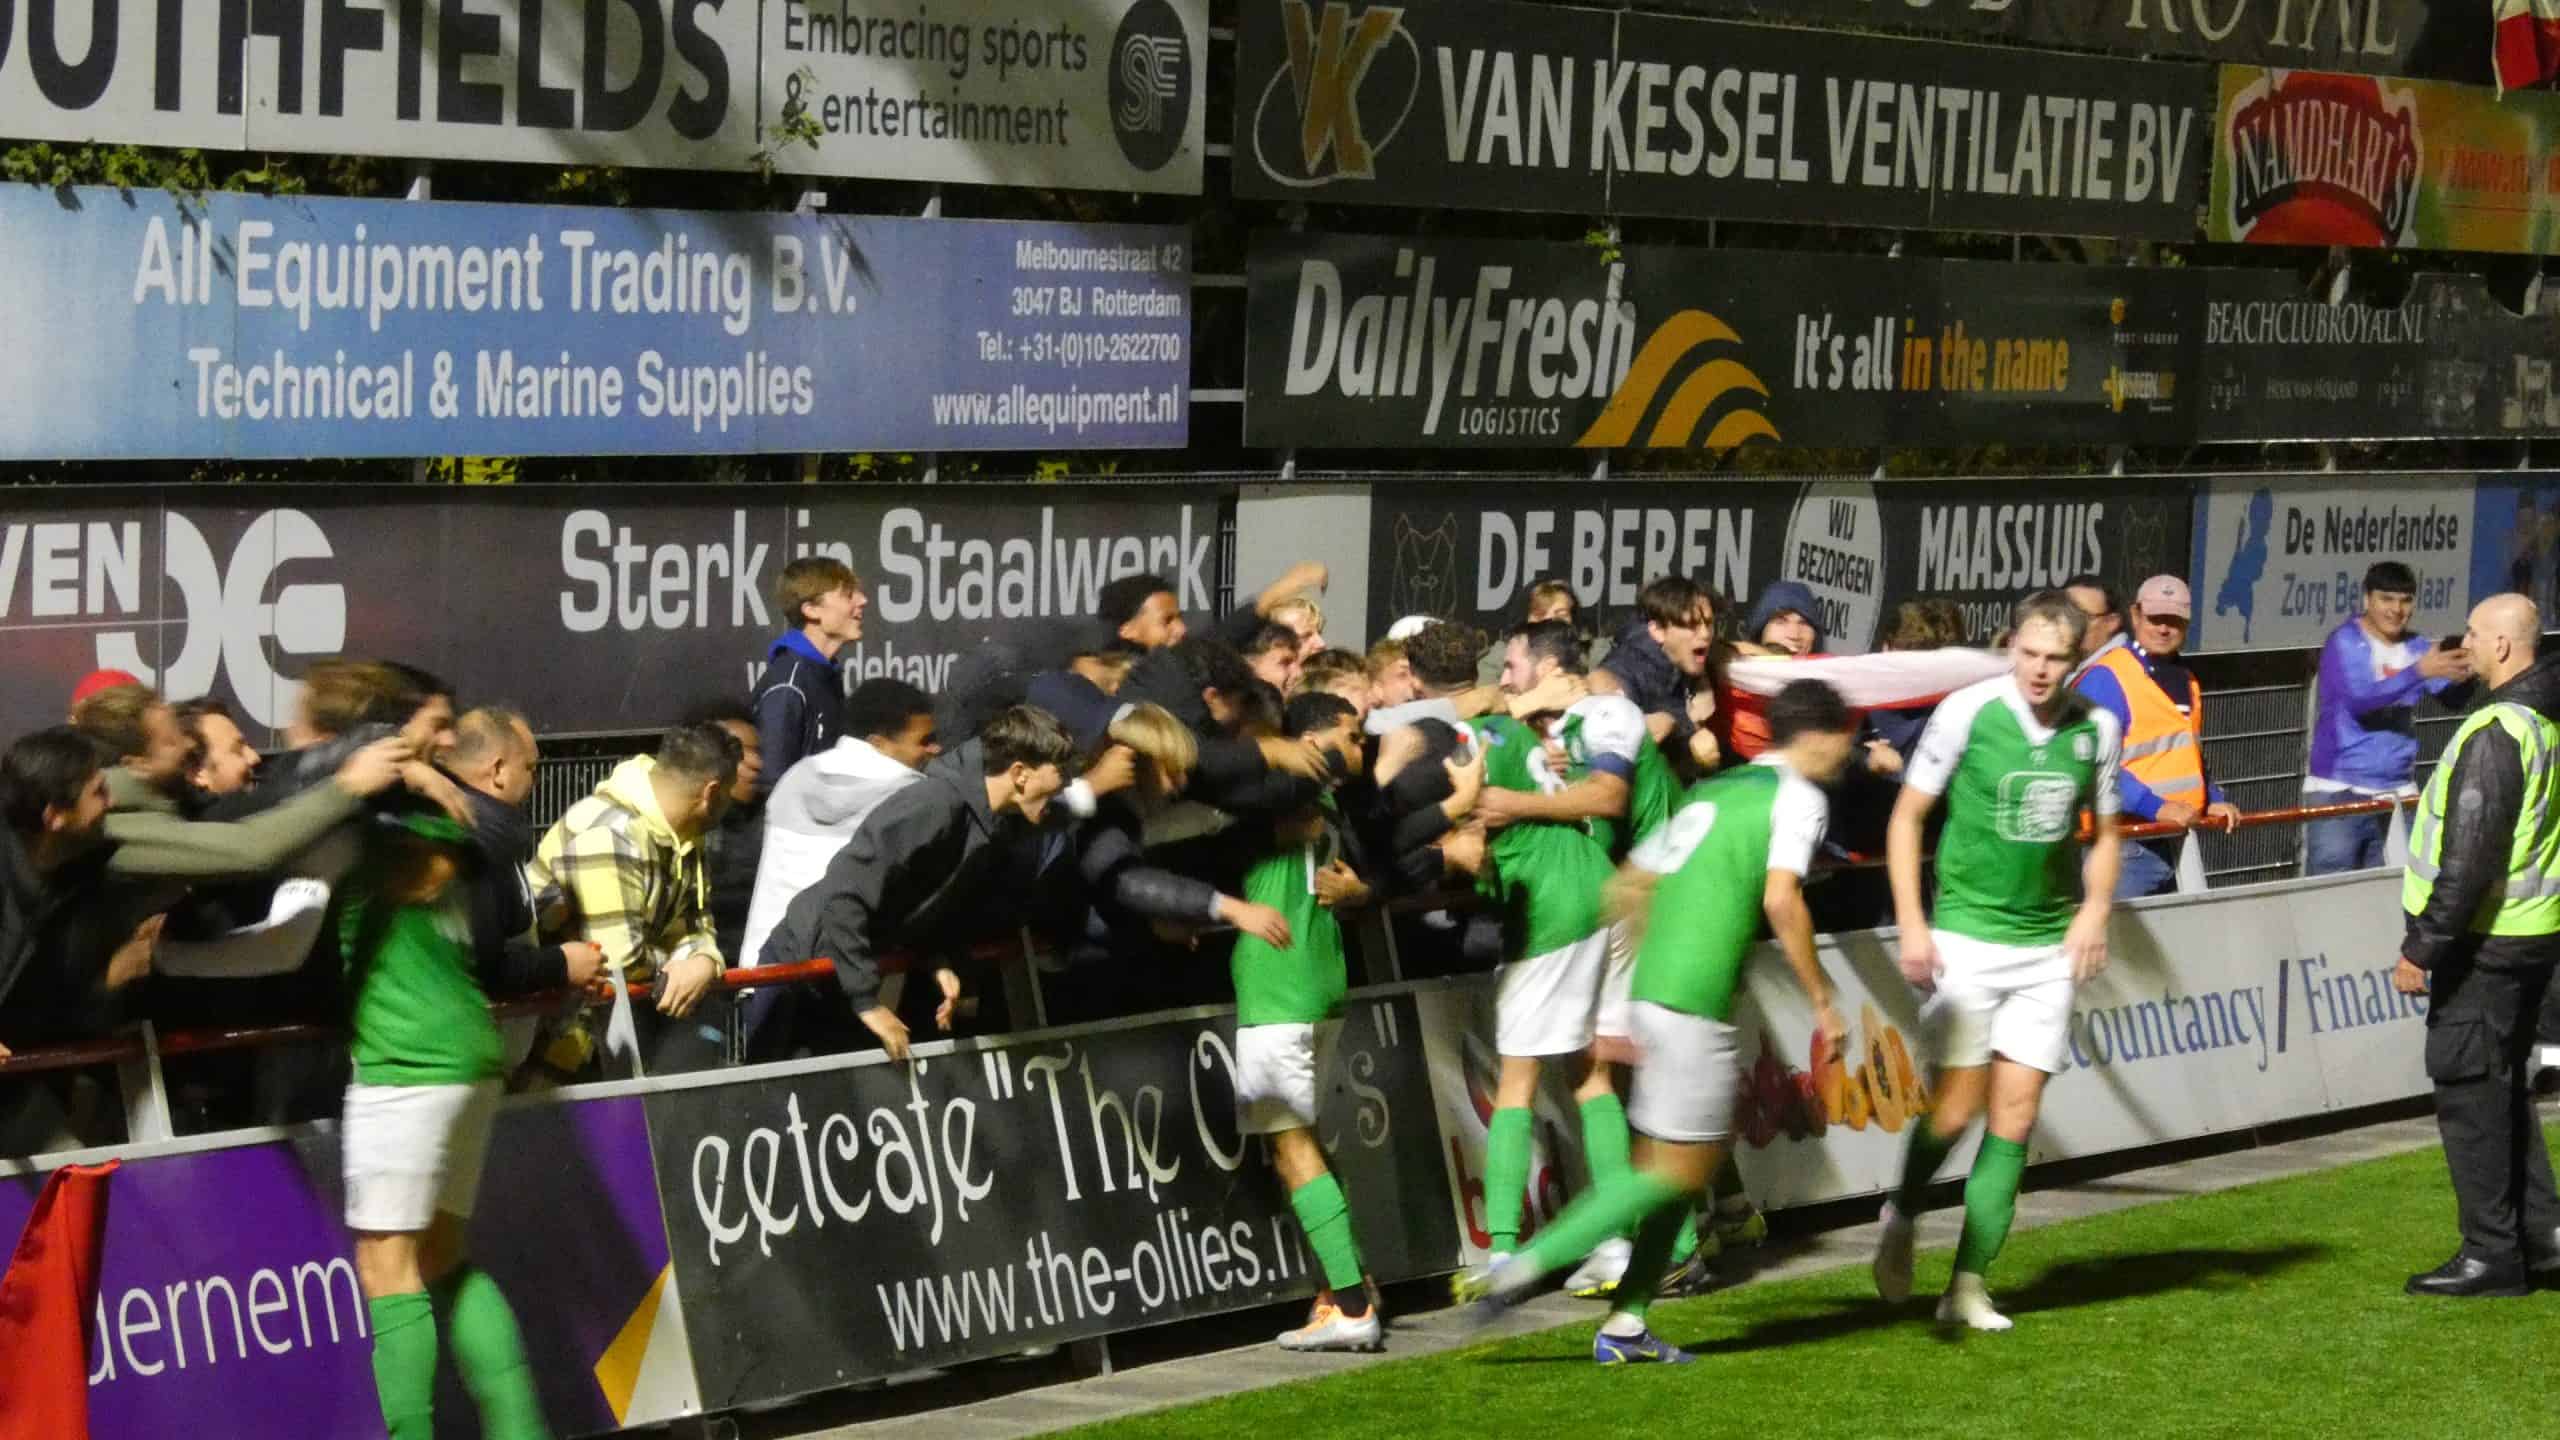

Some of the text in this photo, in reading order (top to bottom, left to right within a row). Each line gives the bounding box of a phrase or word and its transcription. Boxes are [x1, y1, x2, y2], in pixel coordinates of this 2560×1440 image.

[784, 0, 1088, 80] Embracing sports
[0, 0, 730, 141] UTHFIELDS
[822, 87, 1069, 147] entertainment
[1437, 46, 2194, 204] VAN KESSEL VENTILATIE BV
[134, 216, 857, 336] All Equipment Trading B.V.
[1015, 239, 1183, 274] Melbournestraat 42
[1011, 287, 1182, 318] 3047 BJ Rotterdam
[2206, 302, 2425, 344] BEACHCLUBROYAL.NL
[976, 331, 1181, 369] Tel.: +31-(0)10-2622700
[1285, 249, 1636, 435] DailyFresh
[1793, 312, 1846, 391] It's
[1851, 316, 1896, 391] all
[1902, 318, 1933, 392] in
[1938, 319, 1989, 392] the
[1992, 337, 2070, 392] name
[188, 347, 815, 433] Technical & Marine Supplies
[932, 384, 1179, 434] www.allequipment.nl
[1458, 406, 1562, 435] LOGISTICS
[1827, 499, 1858, 541] WIJ
[1917, 502, 2105, 592] MAASSLUIS
[2284, 504, 2459, 555] De Nederlandse
[560, 508, 770, 632] Sterk
[878, 505, 1211, 623] Staalwerk
[1476, 508, 1753, 611] DE BEREN
[1797, 541, 1876, 596] BEZORGEN
[2280, 572, 2328, 626] Zorg
